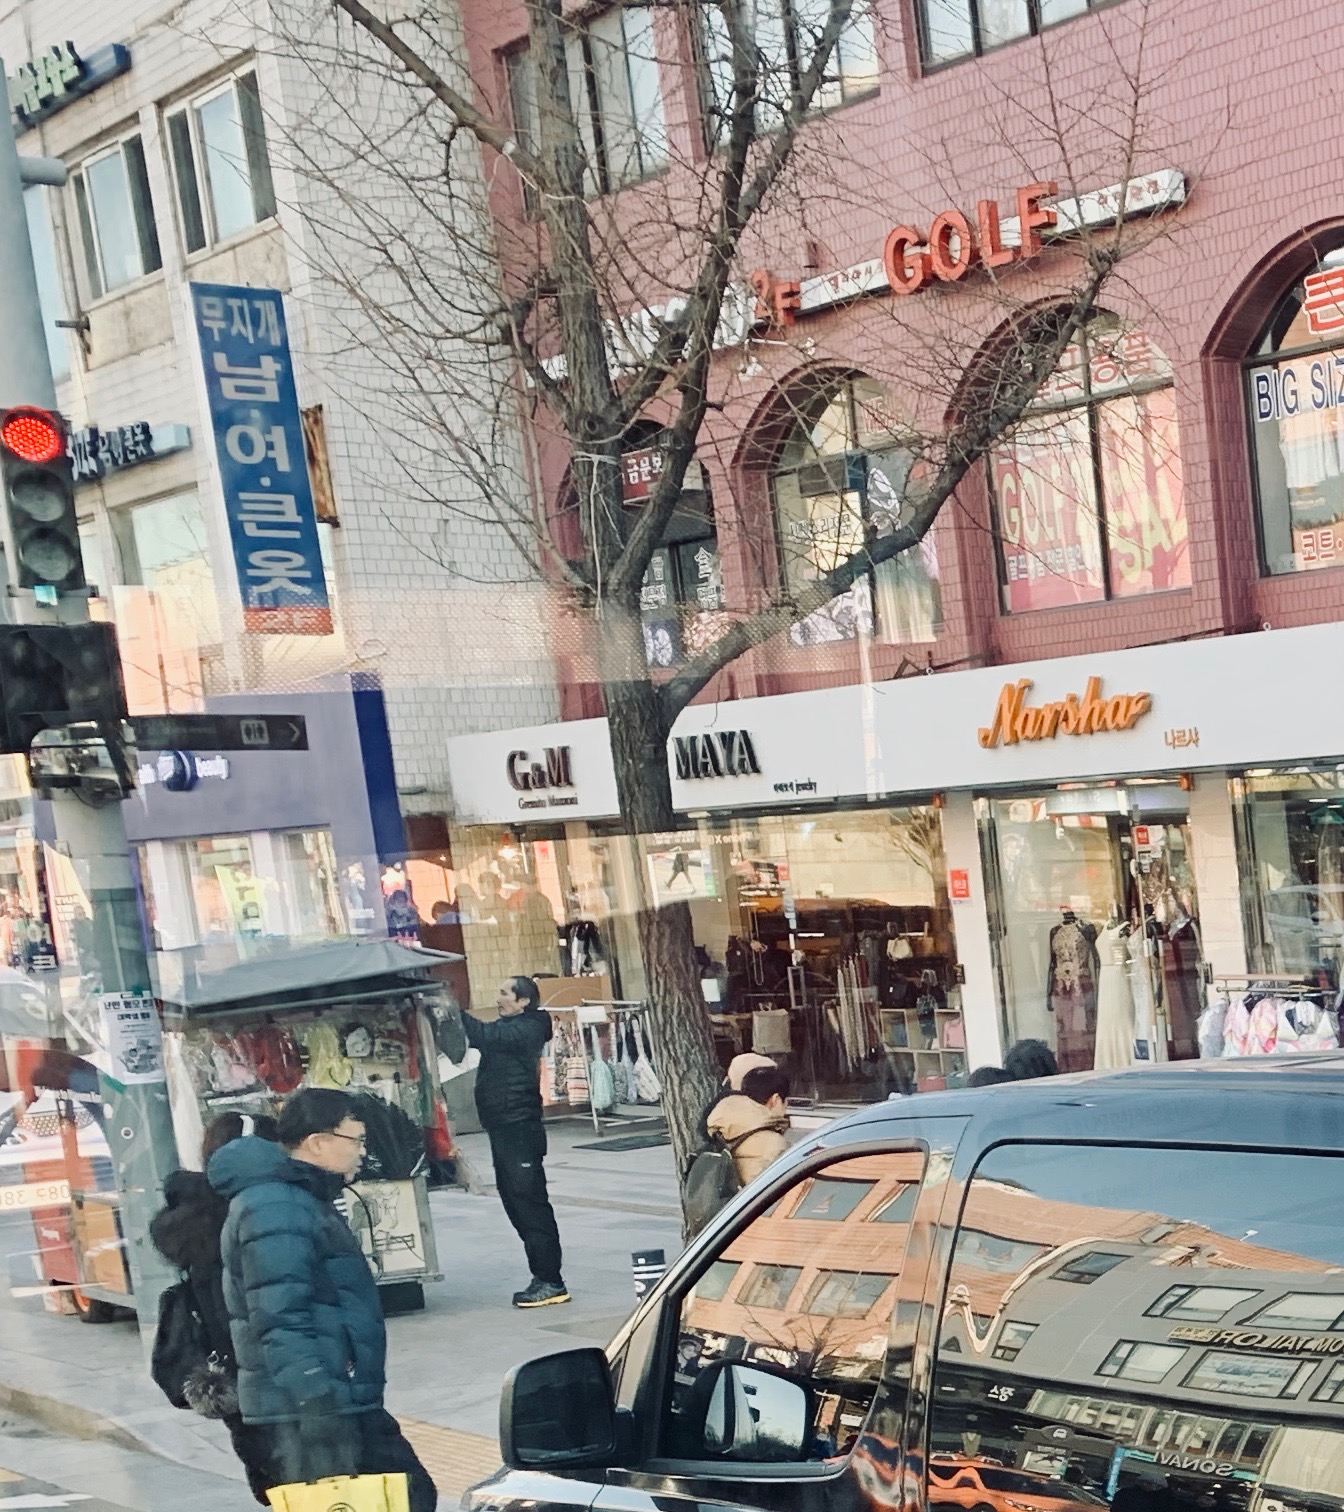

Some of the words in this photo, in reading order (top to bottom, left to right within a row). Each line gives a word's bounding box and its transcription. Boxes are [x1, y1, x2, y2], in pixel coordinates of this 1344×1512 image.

[884, 177, 1058, 295] GOLF
[201, 295, 282, 347] 무지개
[1256, 372, 1301, 423] BIG
[977, 674, 1153, 750] Narsha
[671, 729, 763, 781] MAYA
